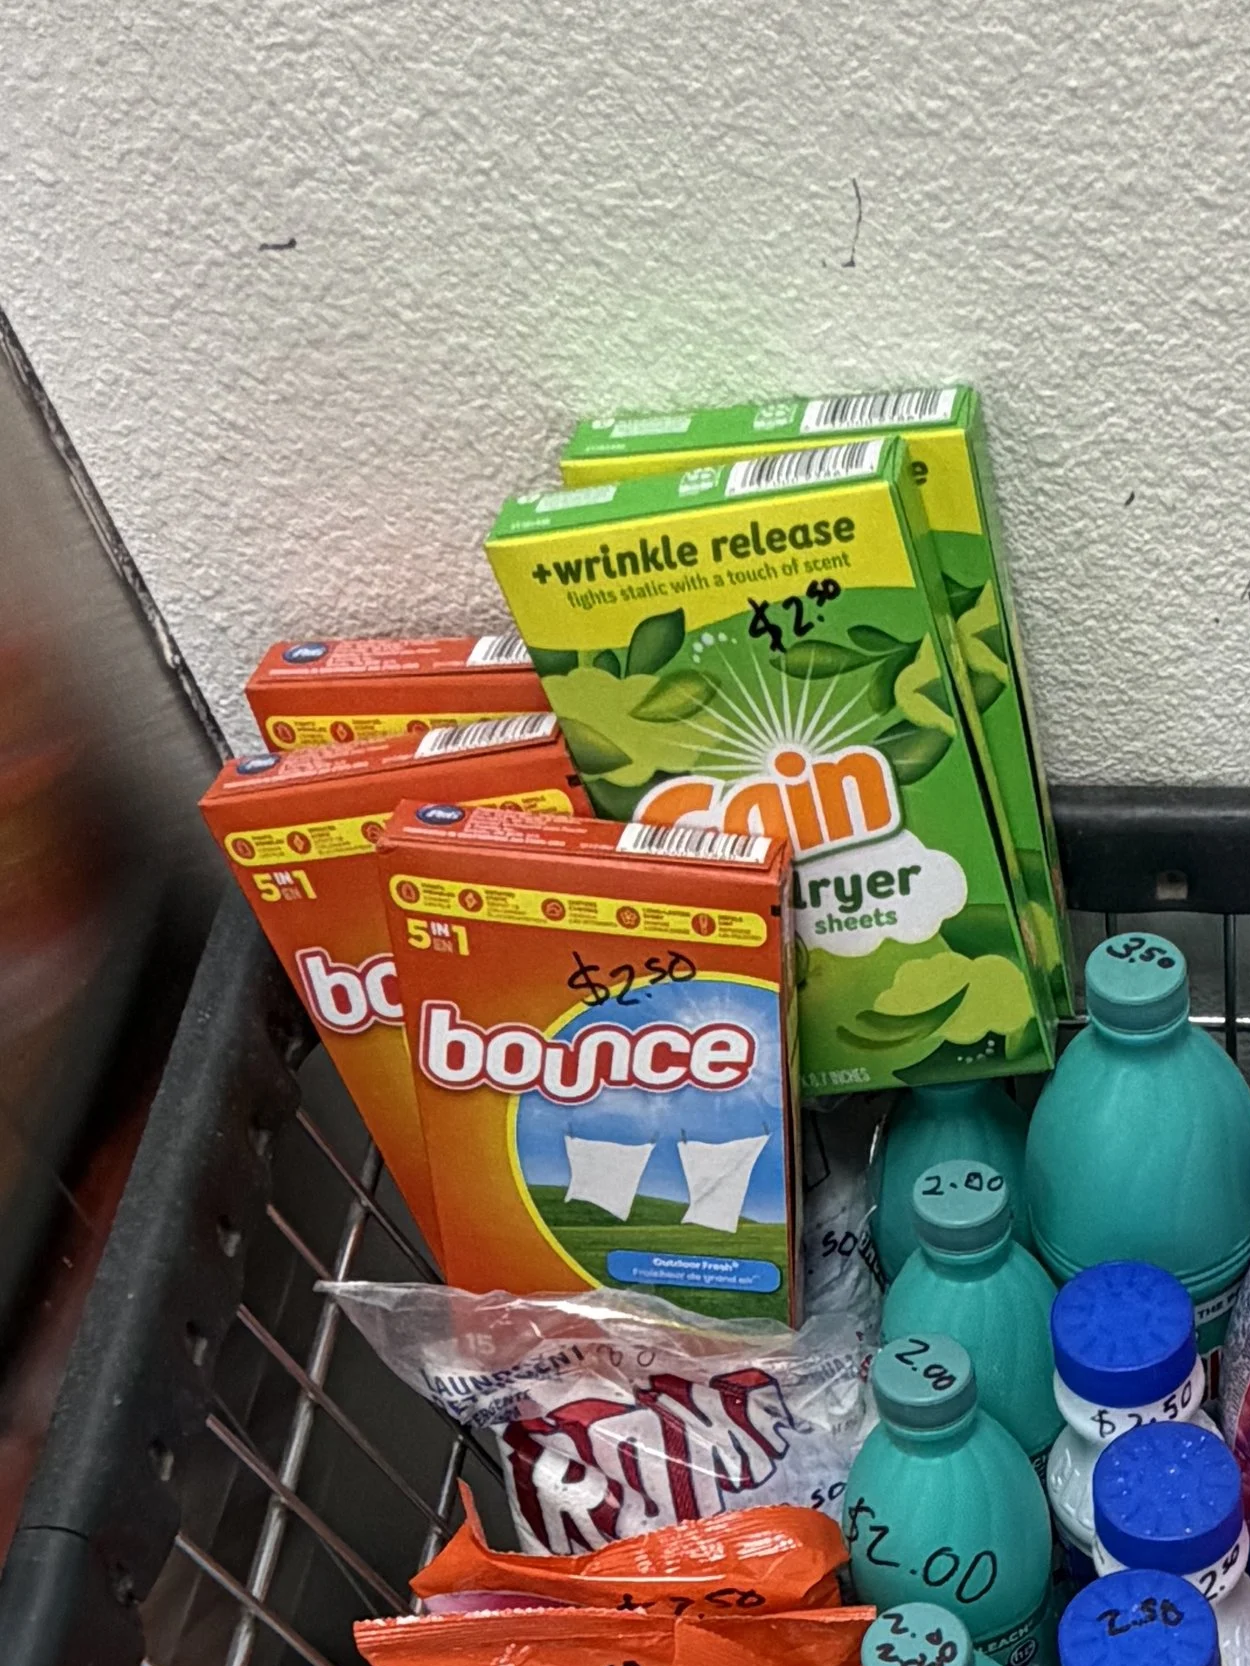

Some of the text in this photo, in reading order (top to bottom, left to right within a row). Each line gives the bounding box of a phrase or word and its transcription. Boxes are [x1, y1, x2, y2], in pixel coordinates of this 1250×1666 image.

[532, 515, 856, 587] +wrinkle release
[567, 551, 851, 609] fights static with a touch of scent
[253, 871, 280, 902] 5
[273, 870, 296, 886] IN
[293, 869, 317, 900] 1
[406, 918, 432, 951] 5
[430, 921, 450, 938] IN
[450, 924, 470, 956] 1
[814, 907, 899, 935] sheets
[422, 1003, 754, 1103] bounce
[895, 1338, 956, 1392] 2.00
[845, 1497, 998, 1604] $2.00
[1097, 1597, 1186, 1639] 2.50
